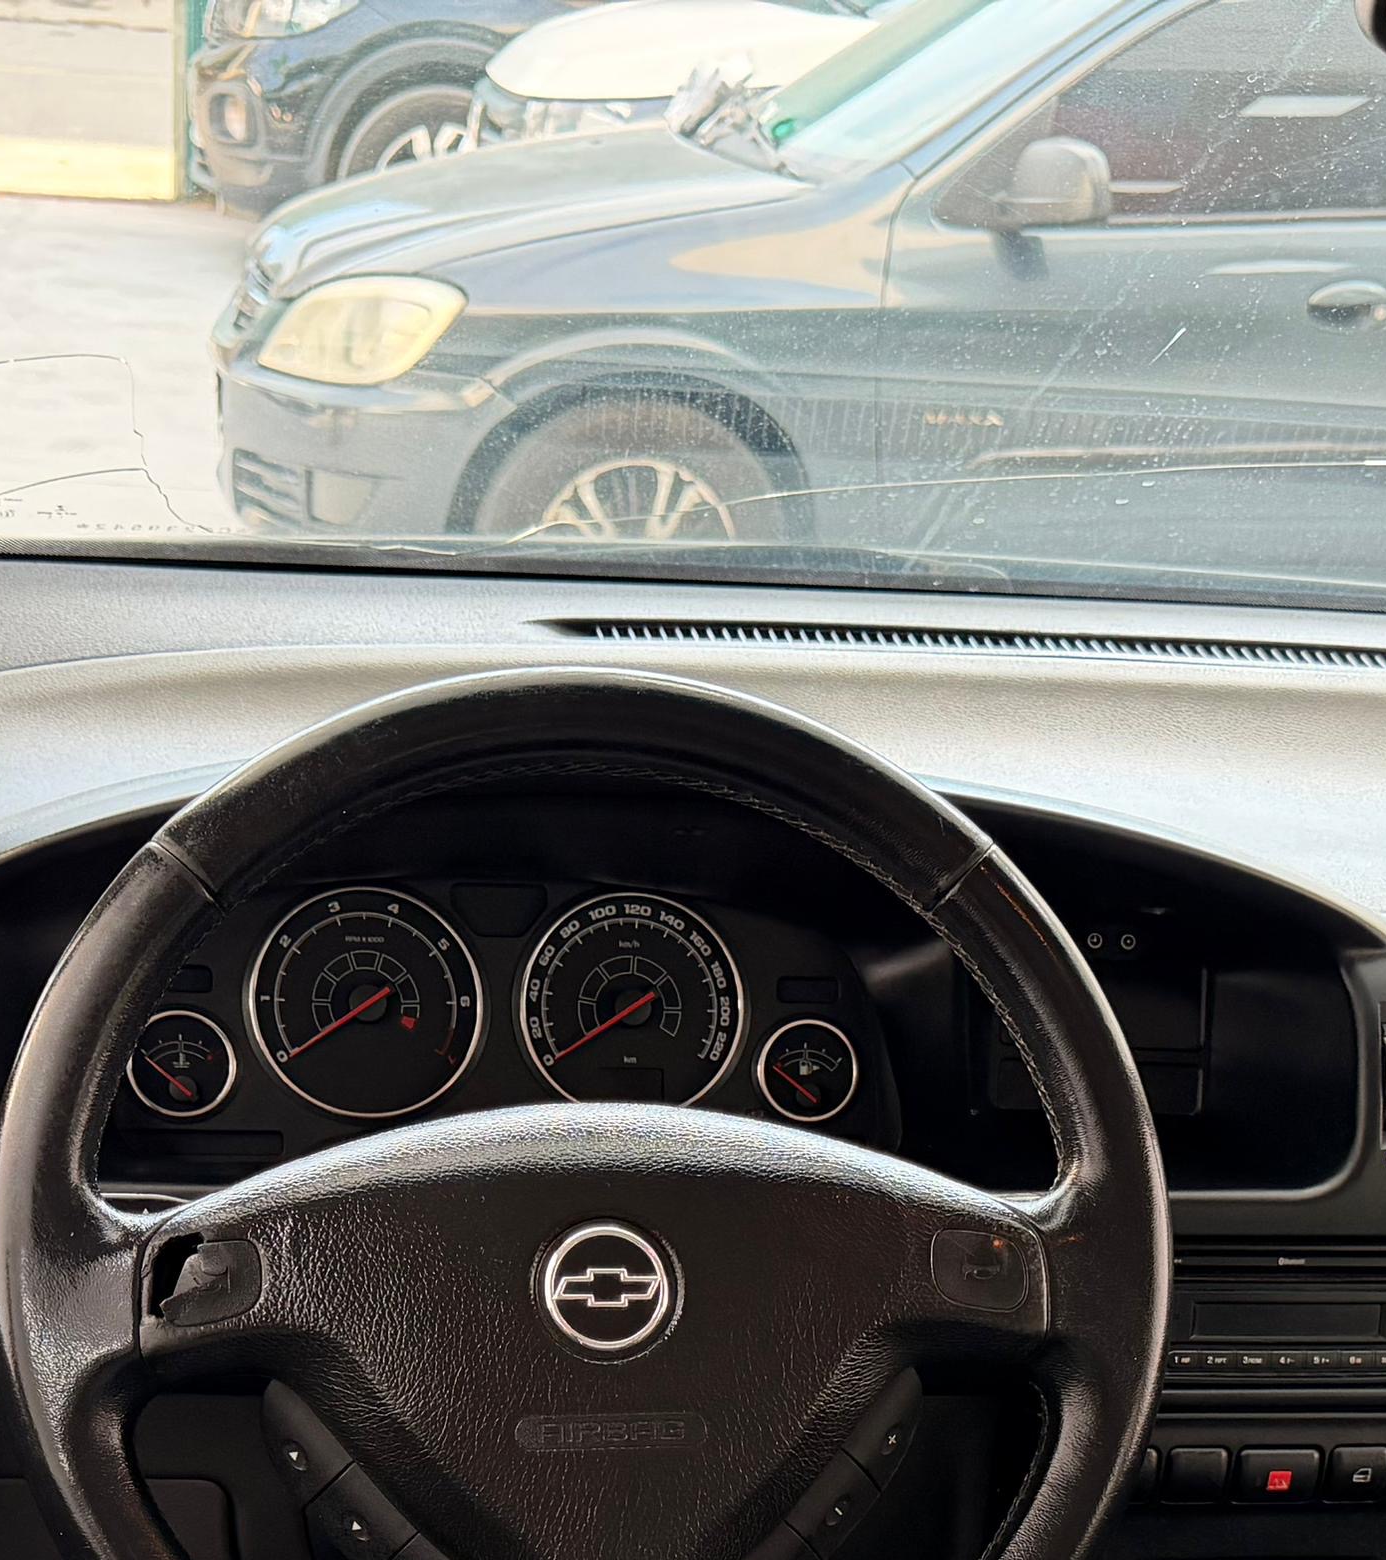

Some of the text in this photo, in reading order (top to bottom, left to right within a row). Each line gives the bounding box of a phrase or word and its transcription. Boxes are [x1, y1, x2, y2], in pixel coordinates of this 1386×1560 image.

[327, 901, 341, 913] 3
[387, 903, 400, 914] 4
[588, 904, 617, 921] 100
[623, 904, 652, 917] 120
[559, 920, 581, 939] 80
[659, 911, 685, 932] 140
[278, 935, 292, 948] 2
[437, 938, 450, 951] 5
[688, 930, 711, 957] 160
[539, 944, 556, 967] 60
[710, 960, 727, 989] 180
[529, 979, 541, 1002] 40
[460, 996, 470, 1007] 6
[718, 996, 731, 1027] 200
[529, 1016, 543, 1039] 20
[709, 1032, 727, 1062] 220
[276, 1050, 289, 1063] 0
[542, 1054, 555, 1066] 0
[623, 1055, 637, 1064] km
[539, 1421, 686, 1444] AIRBAG
